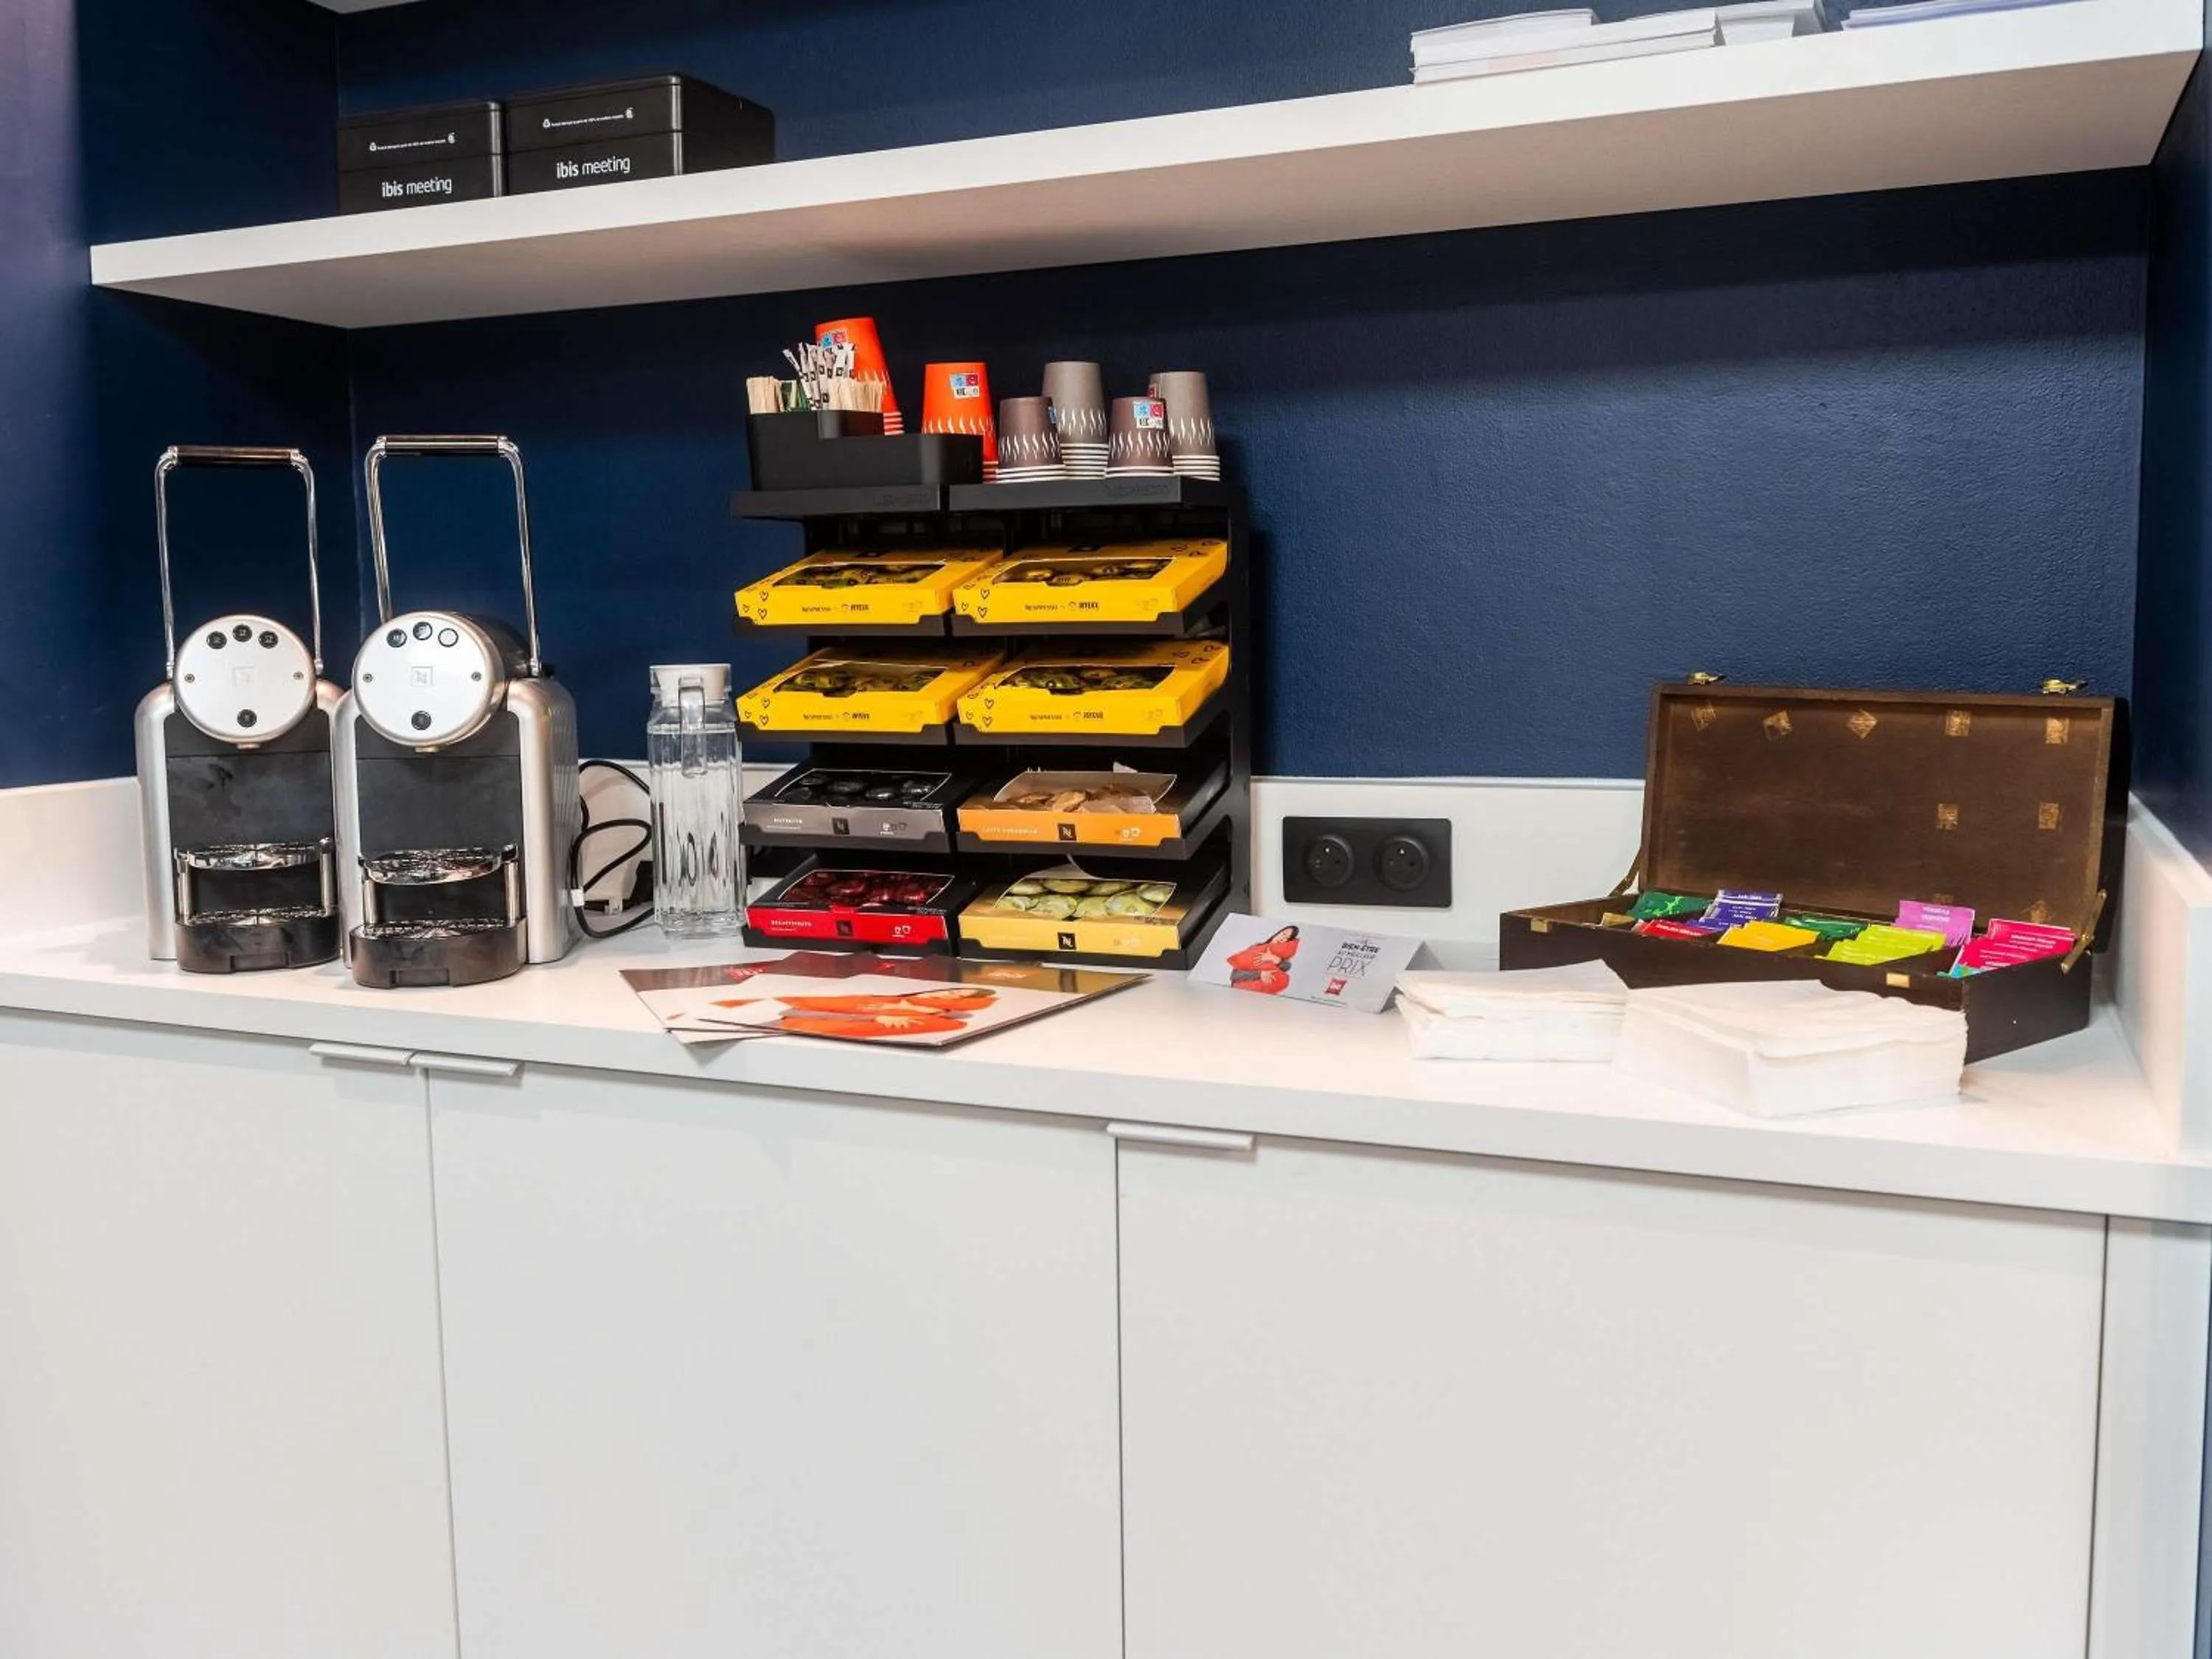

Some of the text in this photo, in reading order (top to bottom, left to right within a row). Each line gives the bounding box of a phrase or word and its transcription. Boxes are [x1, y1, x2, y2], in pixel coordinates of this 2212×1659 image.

[557, 156, 631, 178] ibis meeting
[381, 177, 452, 198] ibis meeting
[1326, 956, 1373, 977] PRIX
